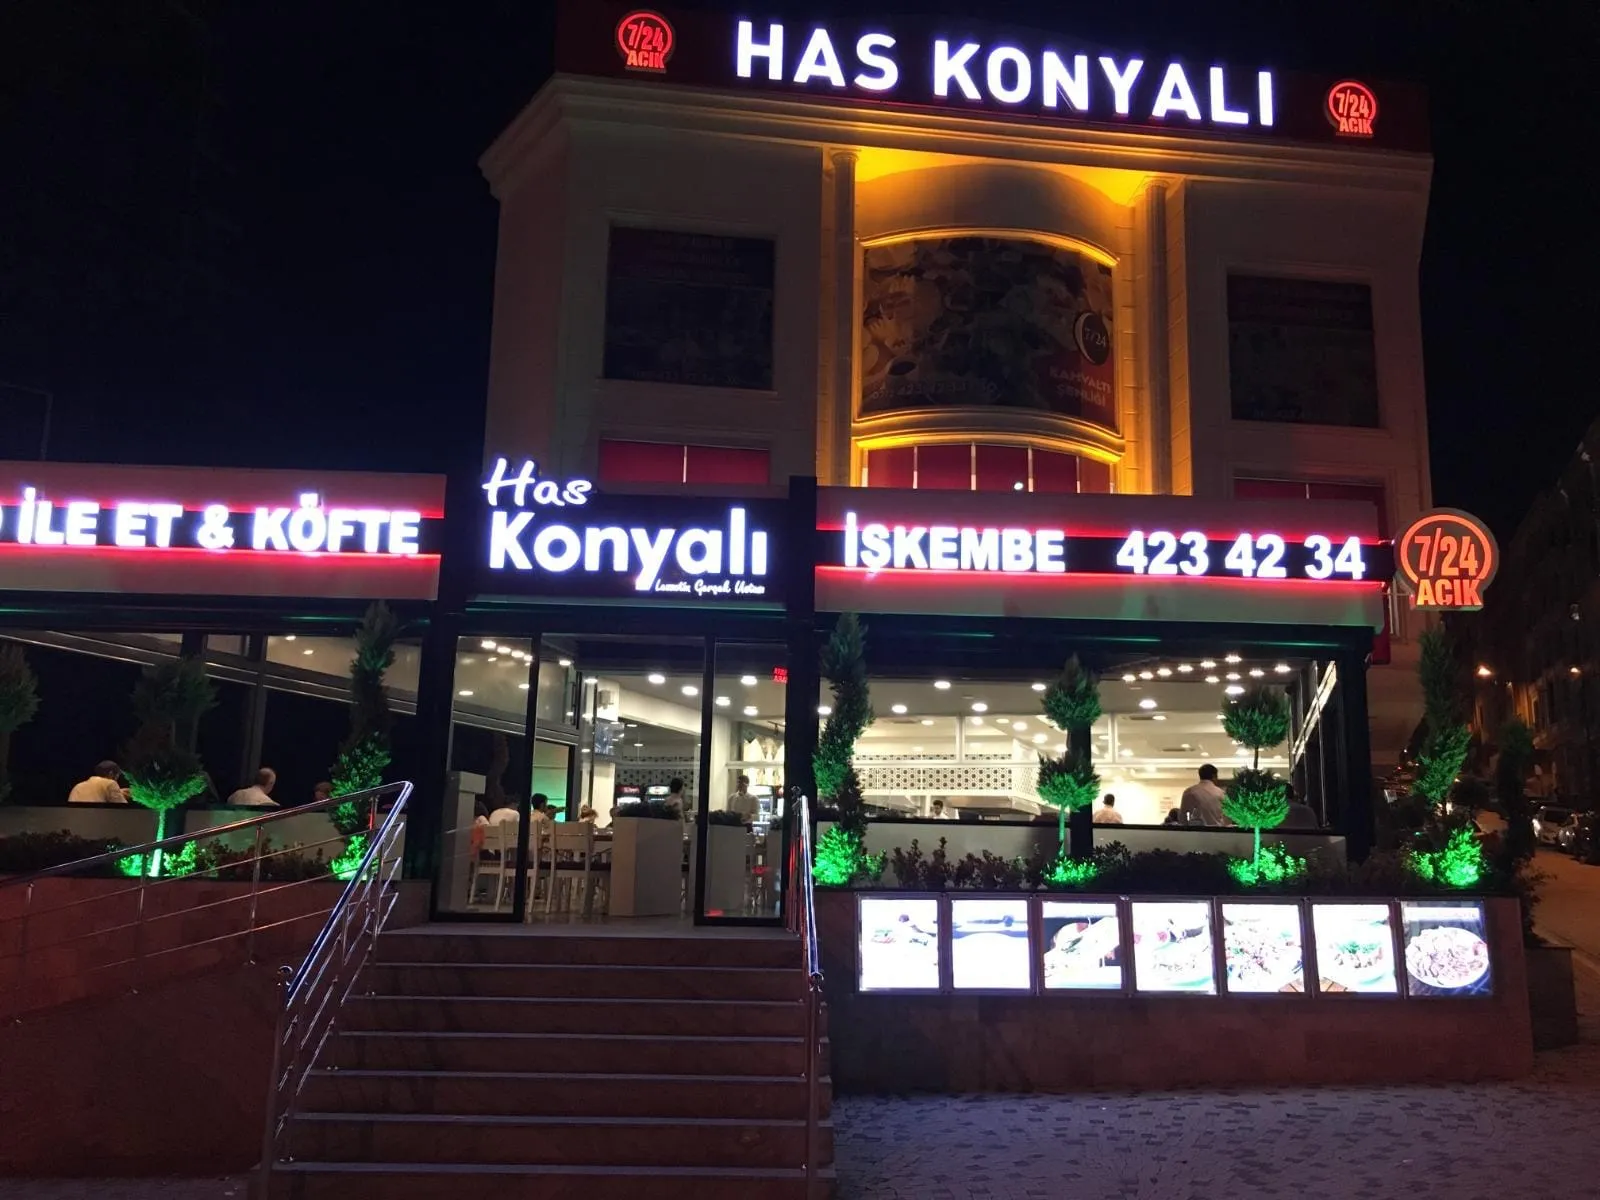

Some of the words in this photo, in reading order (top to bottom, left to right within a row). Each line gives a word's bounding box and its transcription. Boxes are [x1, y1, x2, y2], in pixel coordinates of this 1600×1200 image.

[627, 20, 664, 51] 7/24
[736, 20, 899, 91] HAS
[933, 39, 1274, 126] KONYALI
[1335, 89, 1370, 118] 7/24
[482, 458, 592, 506] Has
[17, 487, 100, 546] İLE
[115, 502, 183, 548] ET
[198, 505, 235, 549] &
[252, 493, 421, 554] KÖFTE
[489, 508, 768, 591] Konyalı
[844, 512, 1066, 573] İŞKEMBE
[1116, 530, 1209, 576] 423
[1224, 533, 1287, 578] 42
[1304, 534, 1366, 580] 34
[1414, 528, 1479, 577] 7/24
